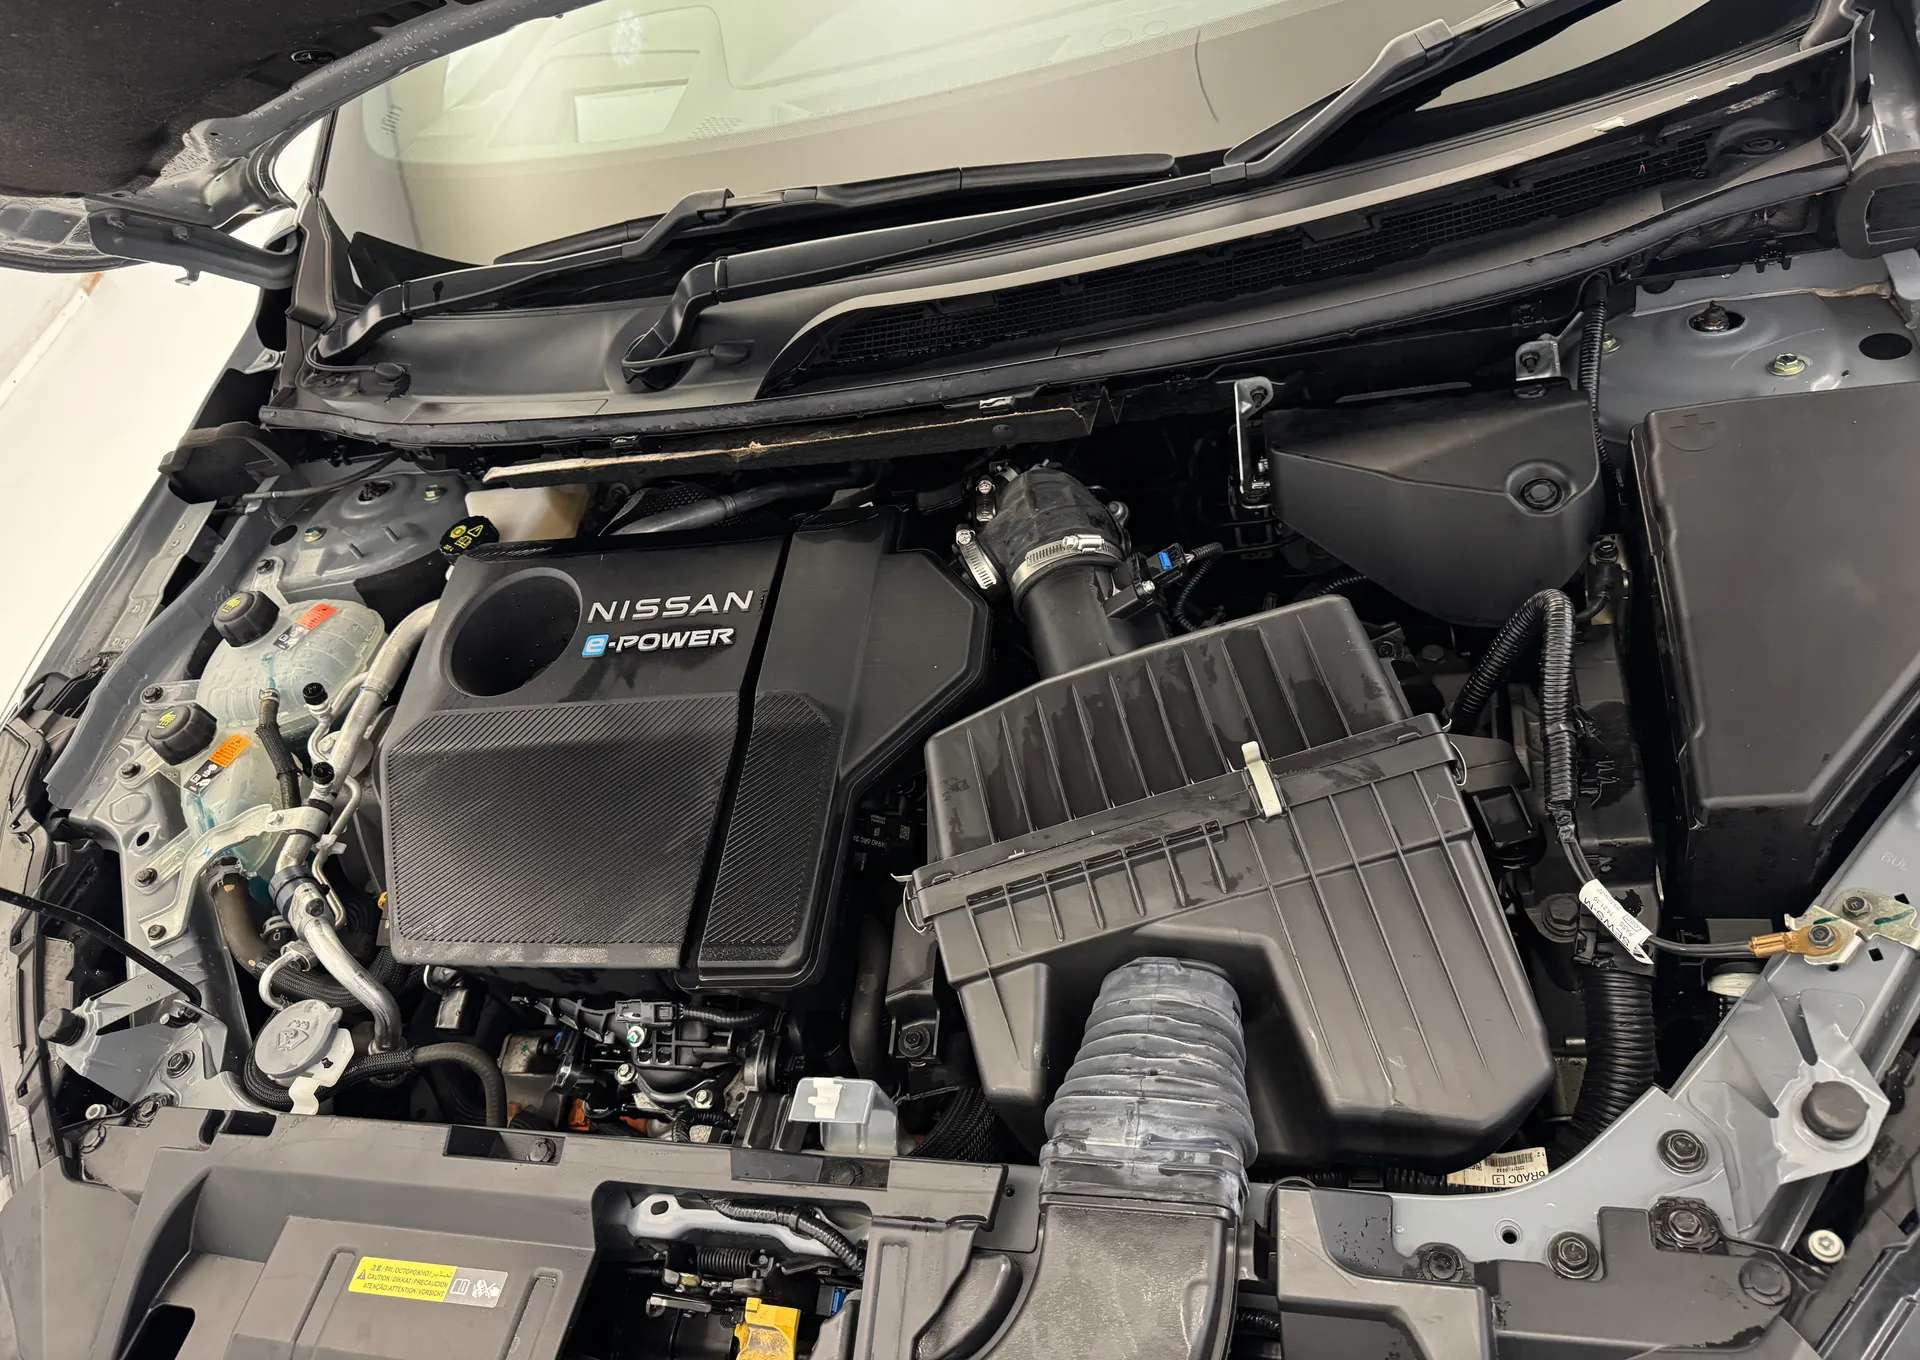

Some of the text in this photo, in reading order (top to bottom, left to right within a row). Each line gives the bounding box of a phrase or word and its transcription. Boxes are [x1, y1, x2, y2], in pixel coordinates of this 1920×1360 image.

[587, 590, 754, 623] NISSAN
[582, 628, 735, 658] e-POWER
[1584, 898, 1630, 947] SEWS-M
